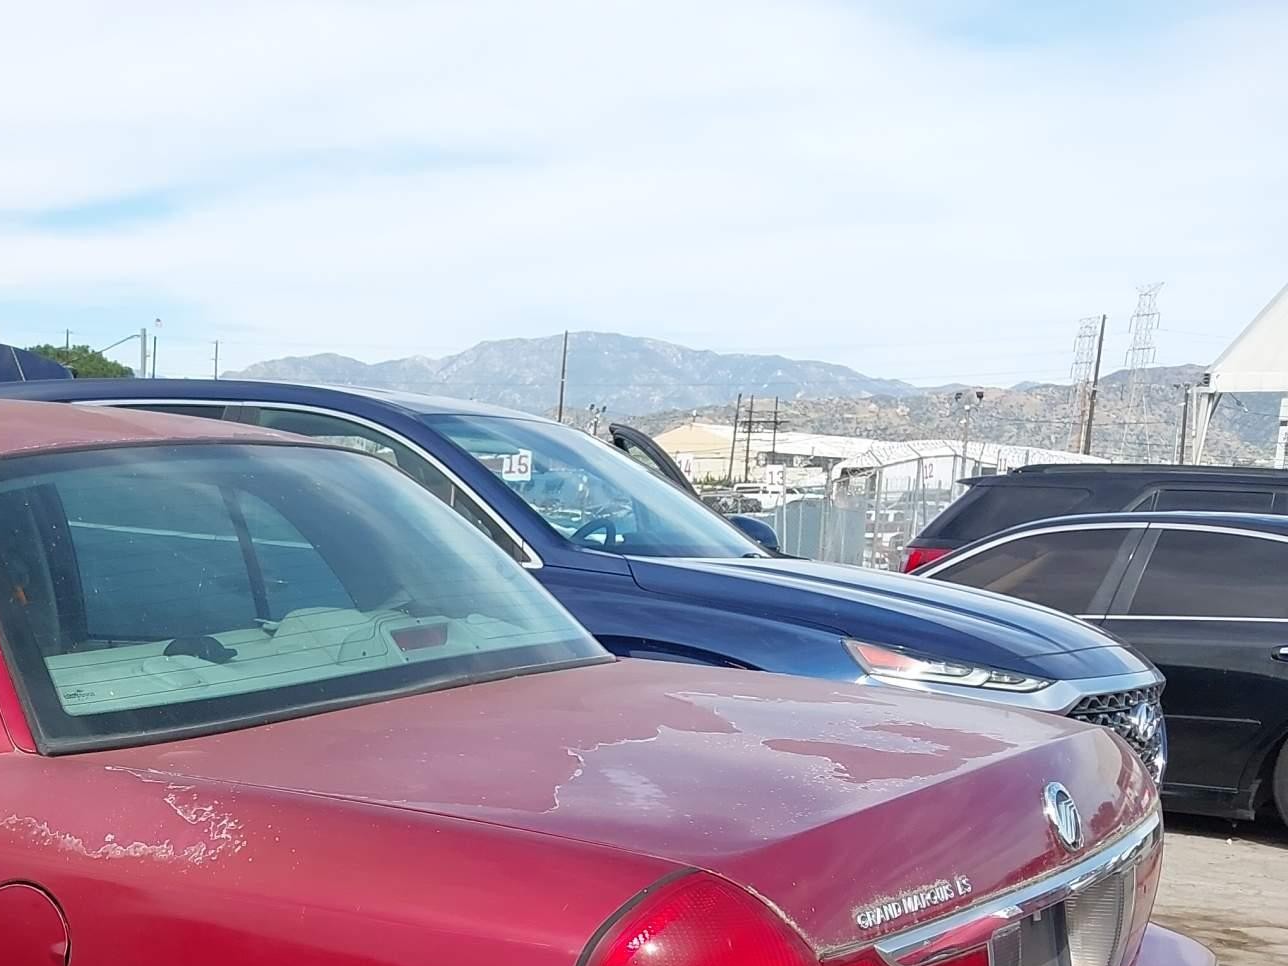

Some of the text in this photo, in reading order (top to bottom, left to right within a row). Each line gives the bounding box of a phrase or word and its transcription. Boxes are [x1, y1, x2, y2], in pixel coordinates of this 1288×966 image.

[503, 454, 529, 474] 15
[924, 463, 934, 480] 12
[768, 470, 785, 486] 13
[856, 902, 902, 929] GRAND
[955, 874, 972, 896] LS
